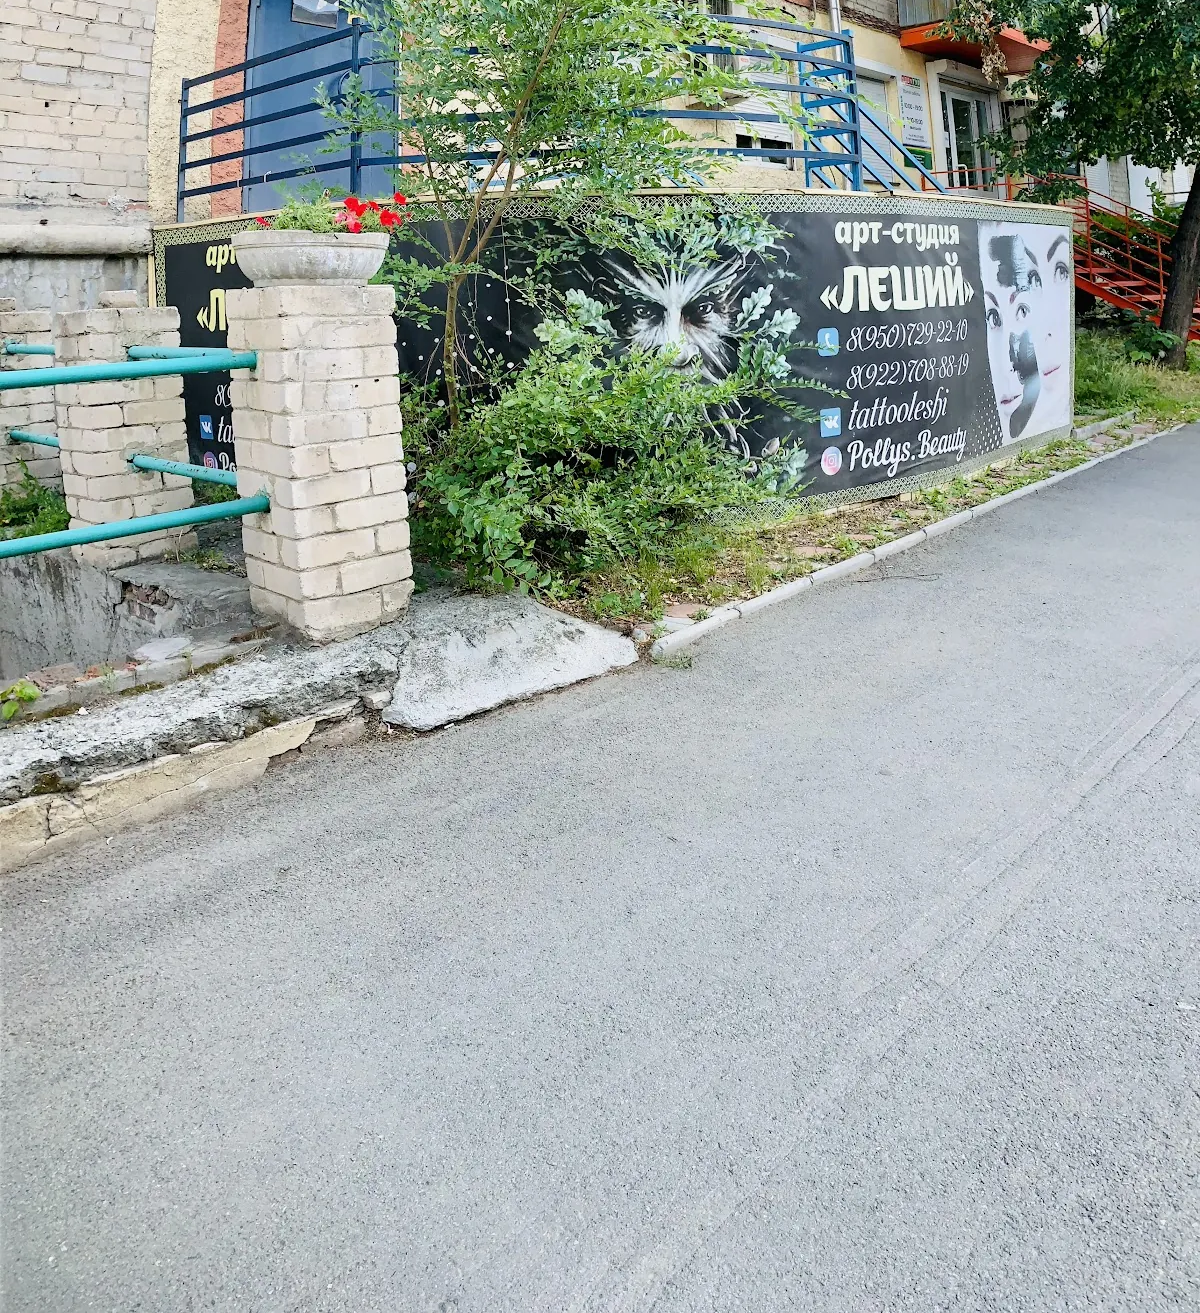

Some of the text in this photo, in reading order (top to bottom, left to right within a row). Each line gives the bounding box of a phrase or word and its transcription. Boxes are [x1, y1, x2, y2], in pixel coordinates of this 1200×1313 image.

[834, 221, 960, 252] арт-студия
[819, 251, 975, 314] «ЛЕШИЙ»
[846, 318, 968, 352] 8(950)729-22-10
[846, 353, 969, 390] 8(922)708-88-19
[848, 386, 949, 431] tattooleshi
